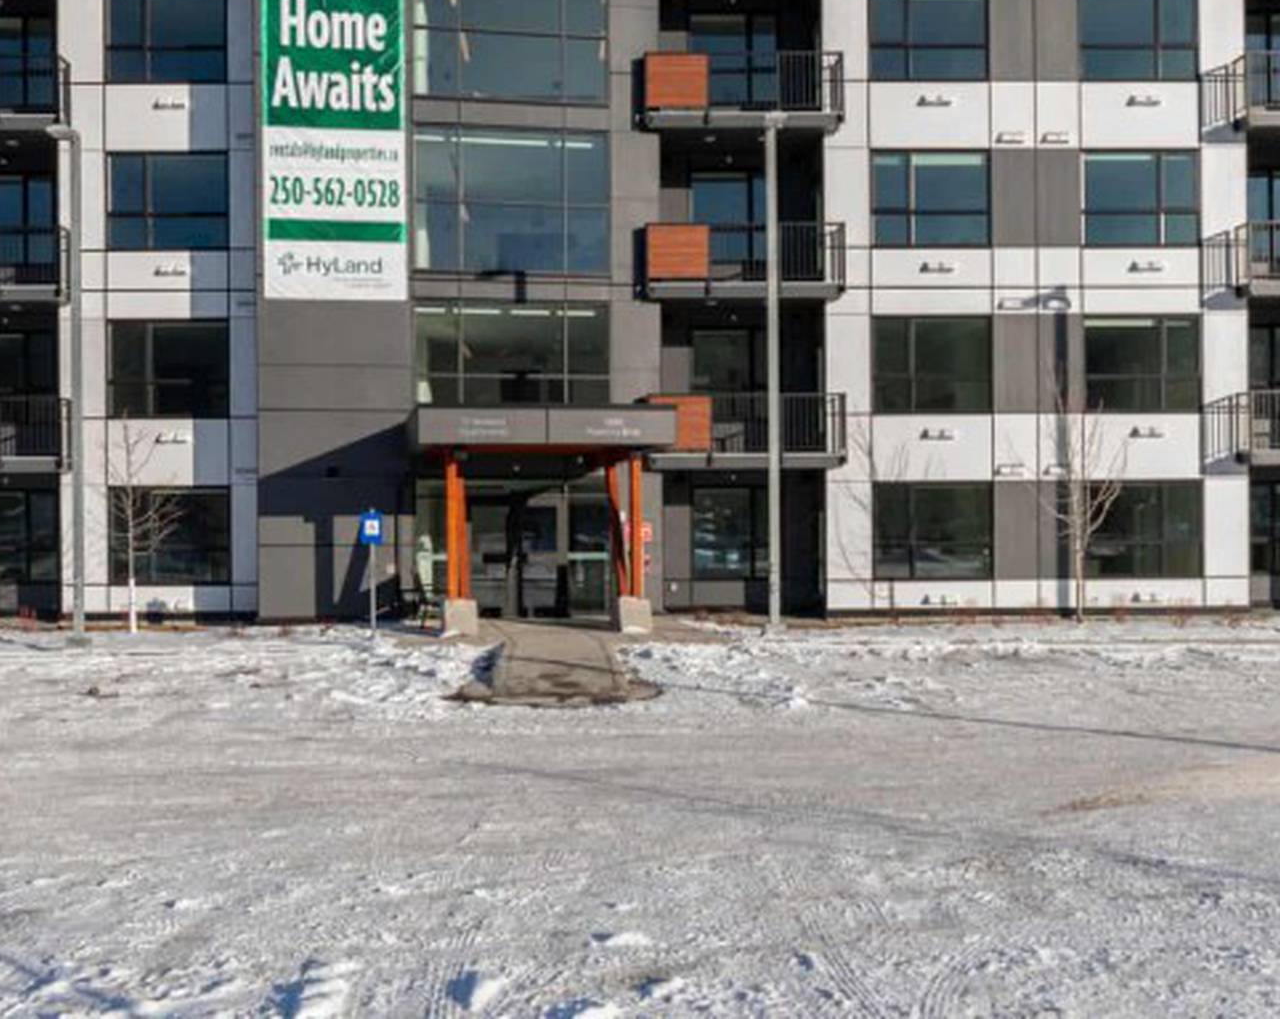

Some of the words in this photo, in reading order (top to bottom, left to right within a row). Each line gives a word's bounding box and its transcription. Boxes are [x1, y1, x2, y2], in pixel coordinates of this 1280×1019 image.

[271, 55, 395, 112] Awaits
[270, 176, 400, 207] 250-562-0528
[306, 256, 383, 276] HyLand
